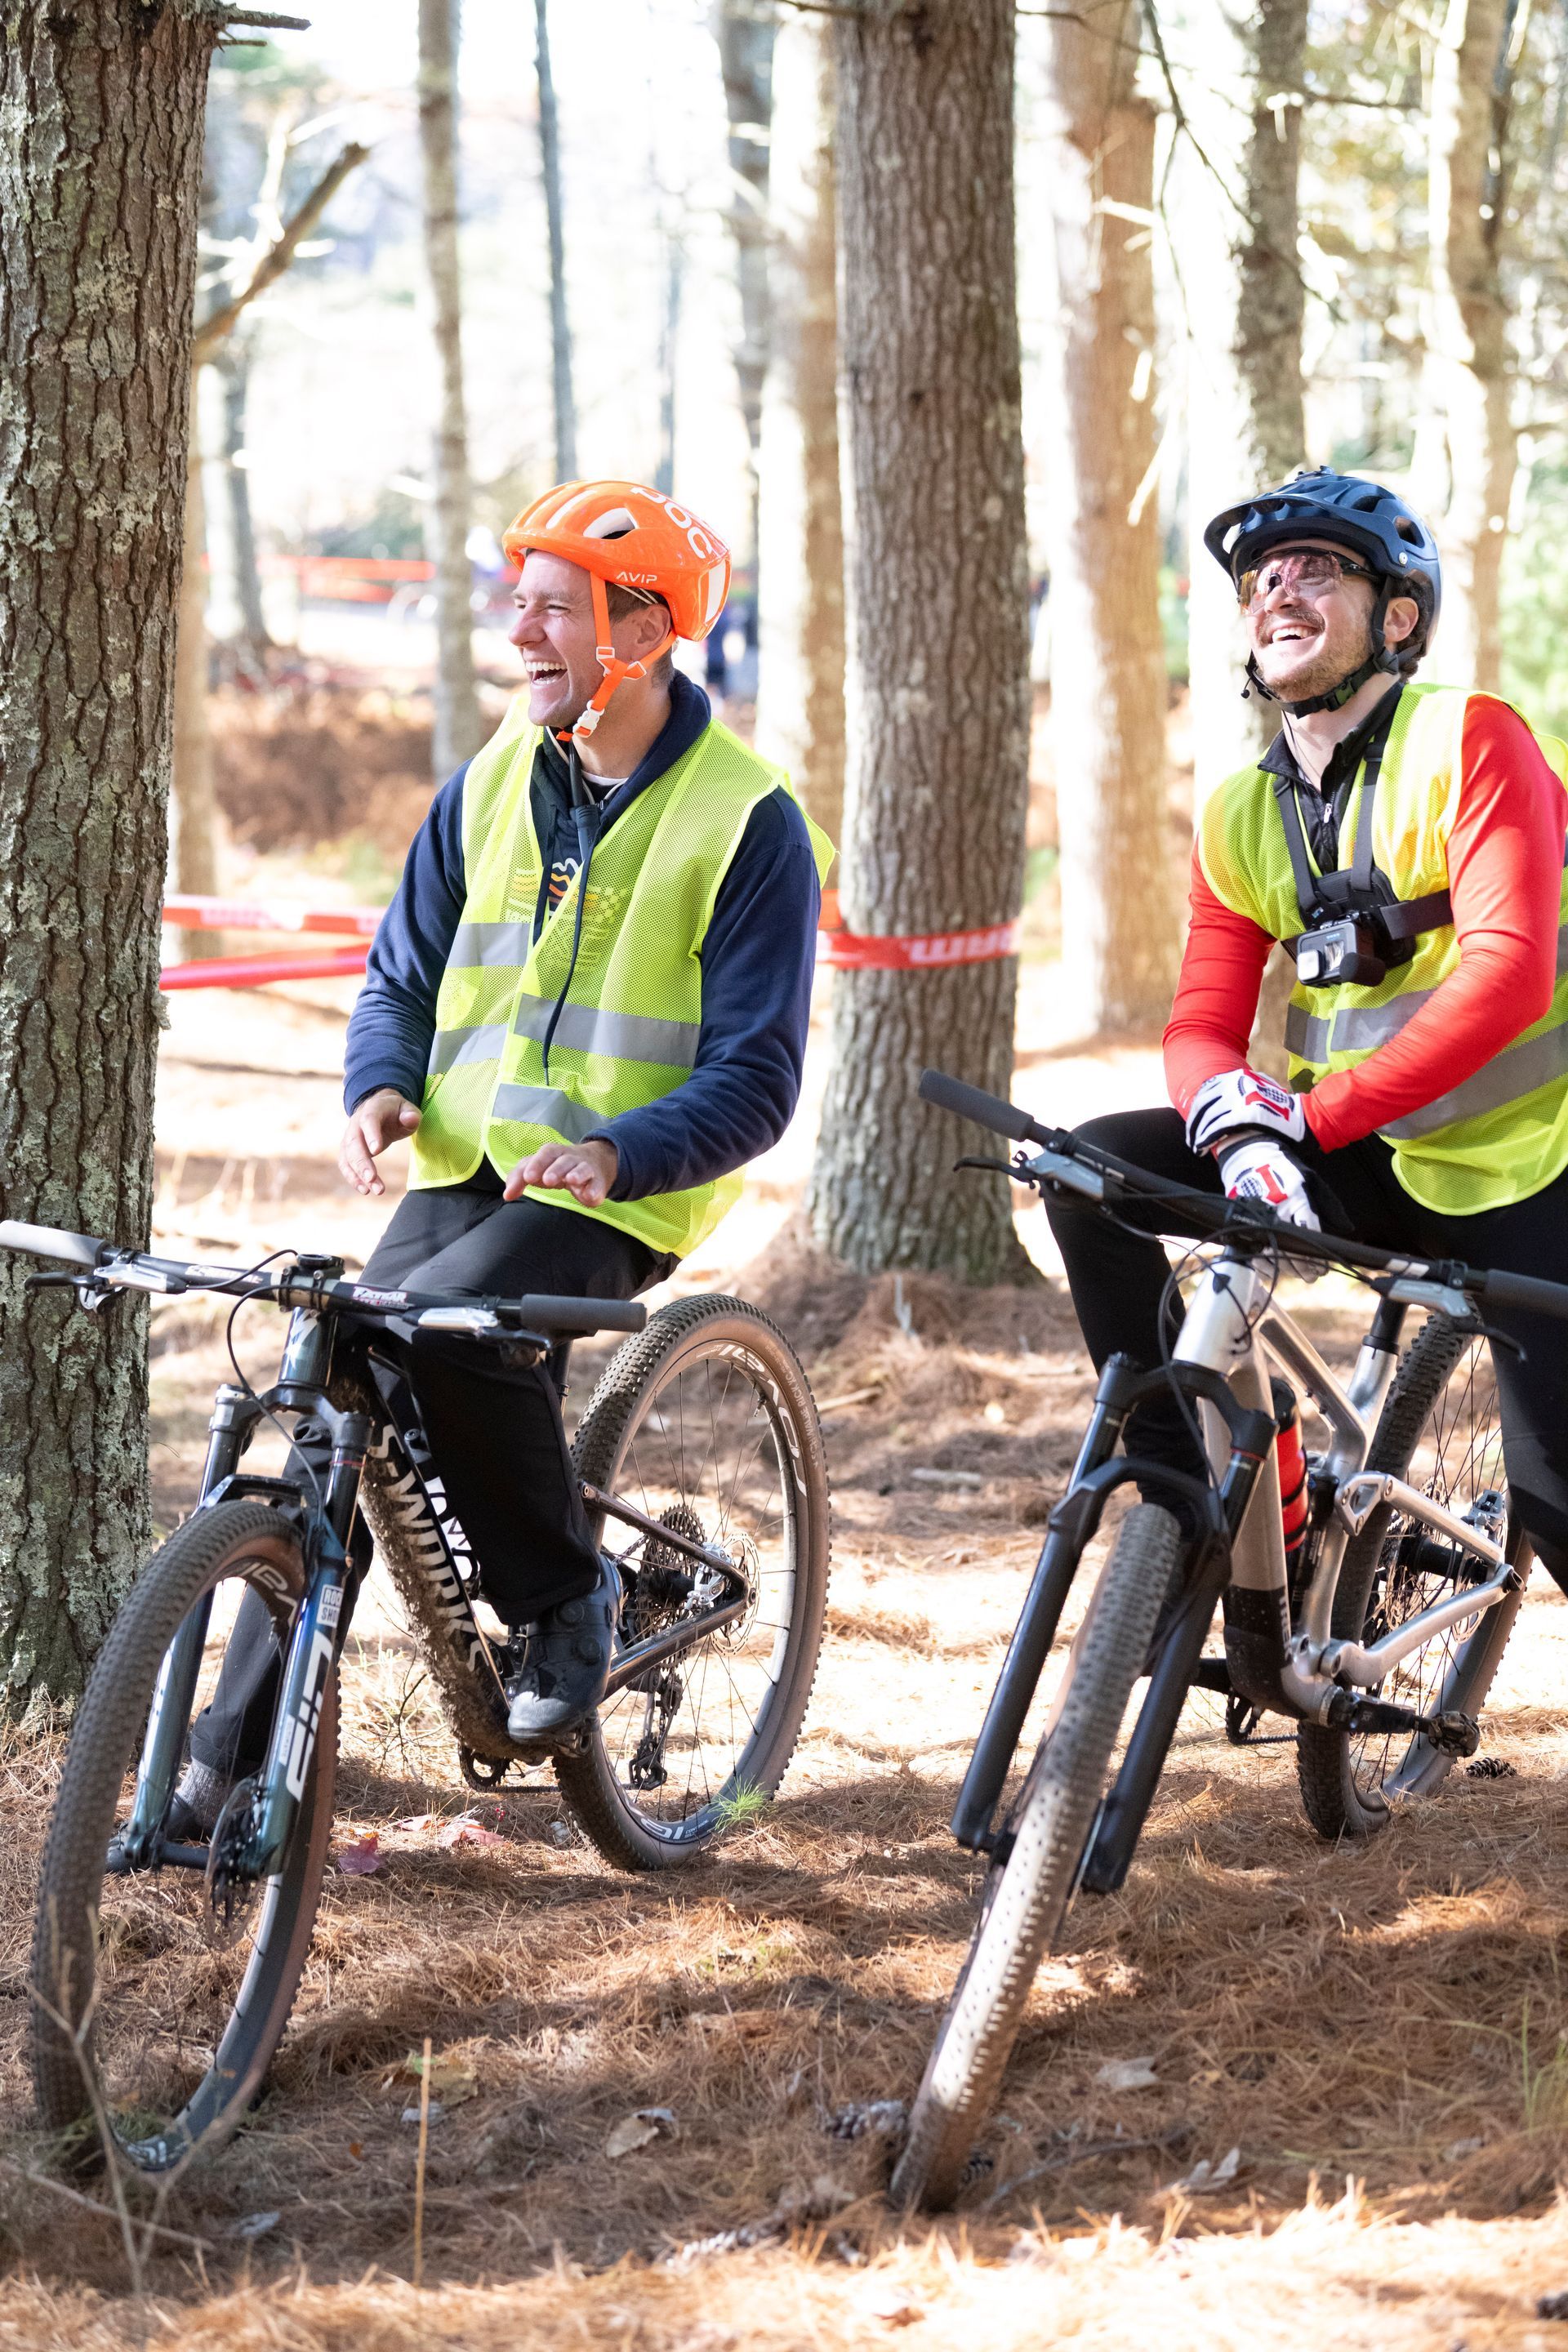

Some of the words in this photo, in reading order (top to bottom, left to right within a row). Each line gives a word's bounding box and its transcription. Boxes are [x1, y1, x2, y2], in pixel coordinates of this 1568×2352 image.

[616, 571, 657, 584] AVIP
[785, 1371, 797, 1386] XC
[792, 1386, 806, 1407] RICK
